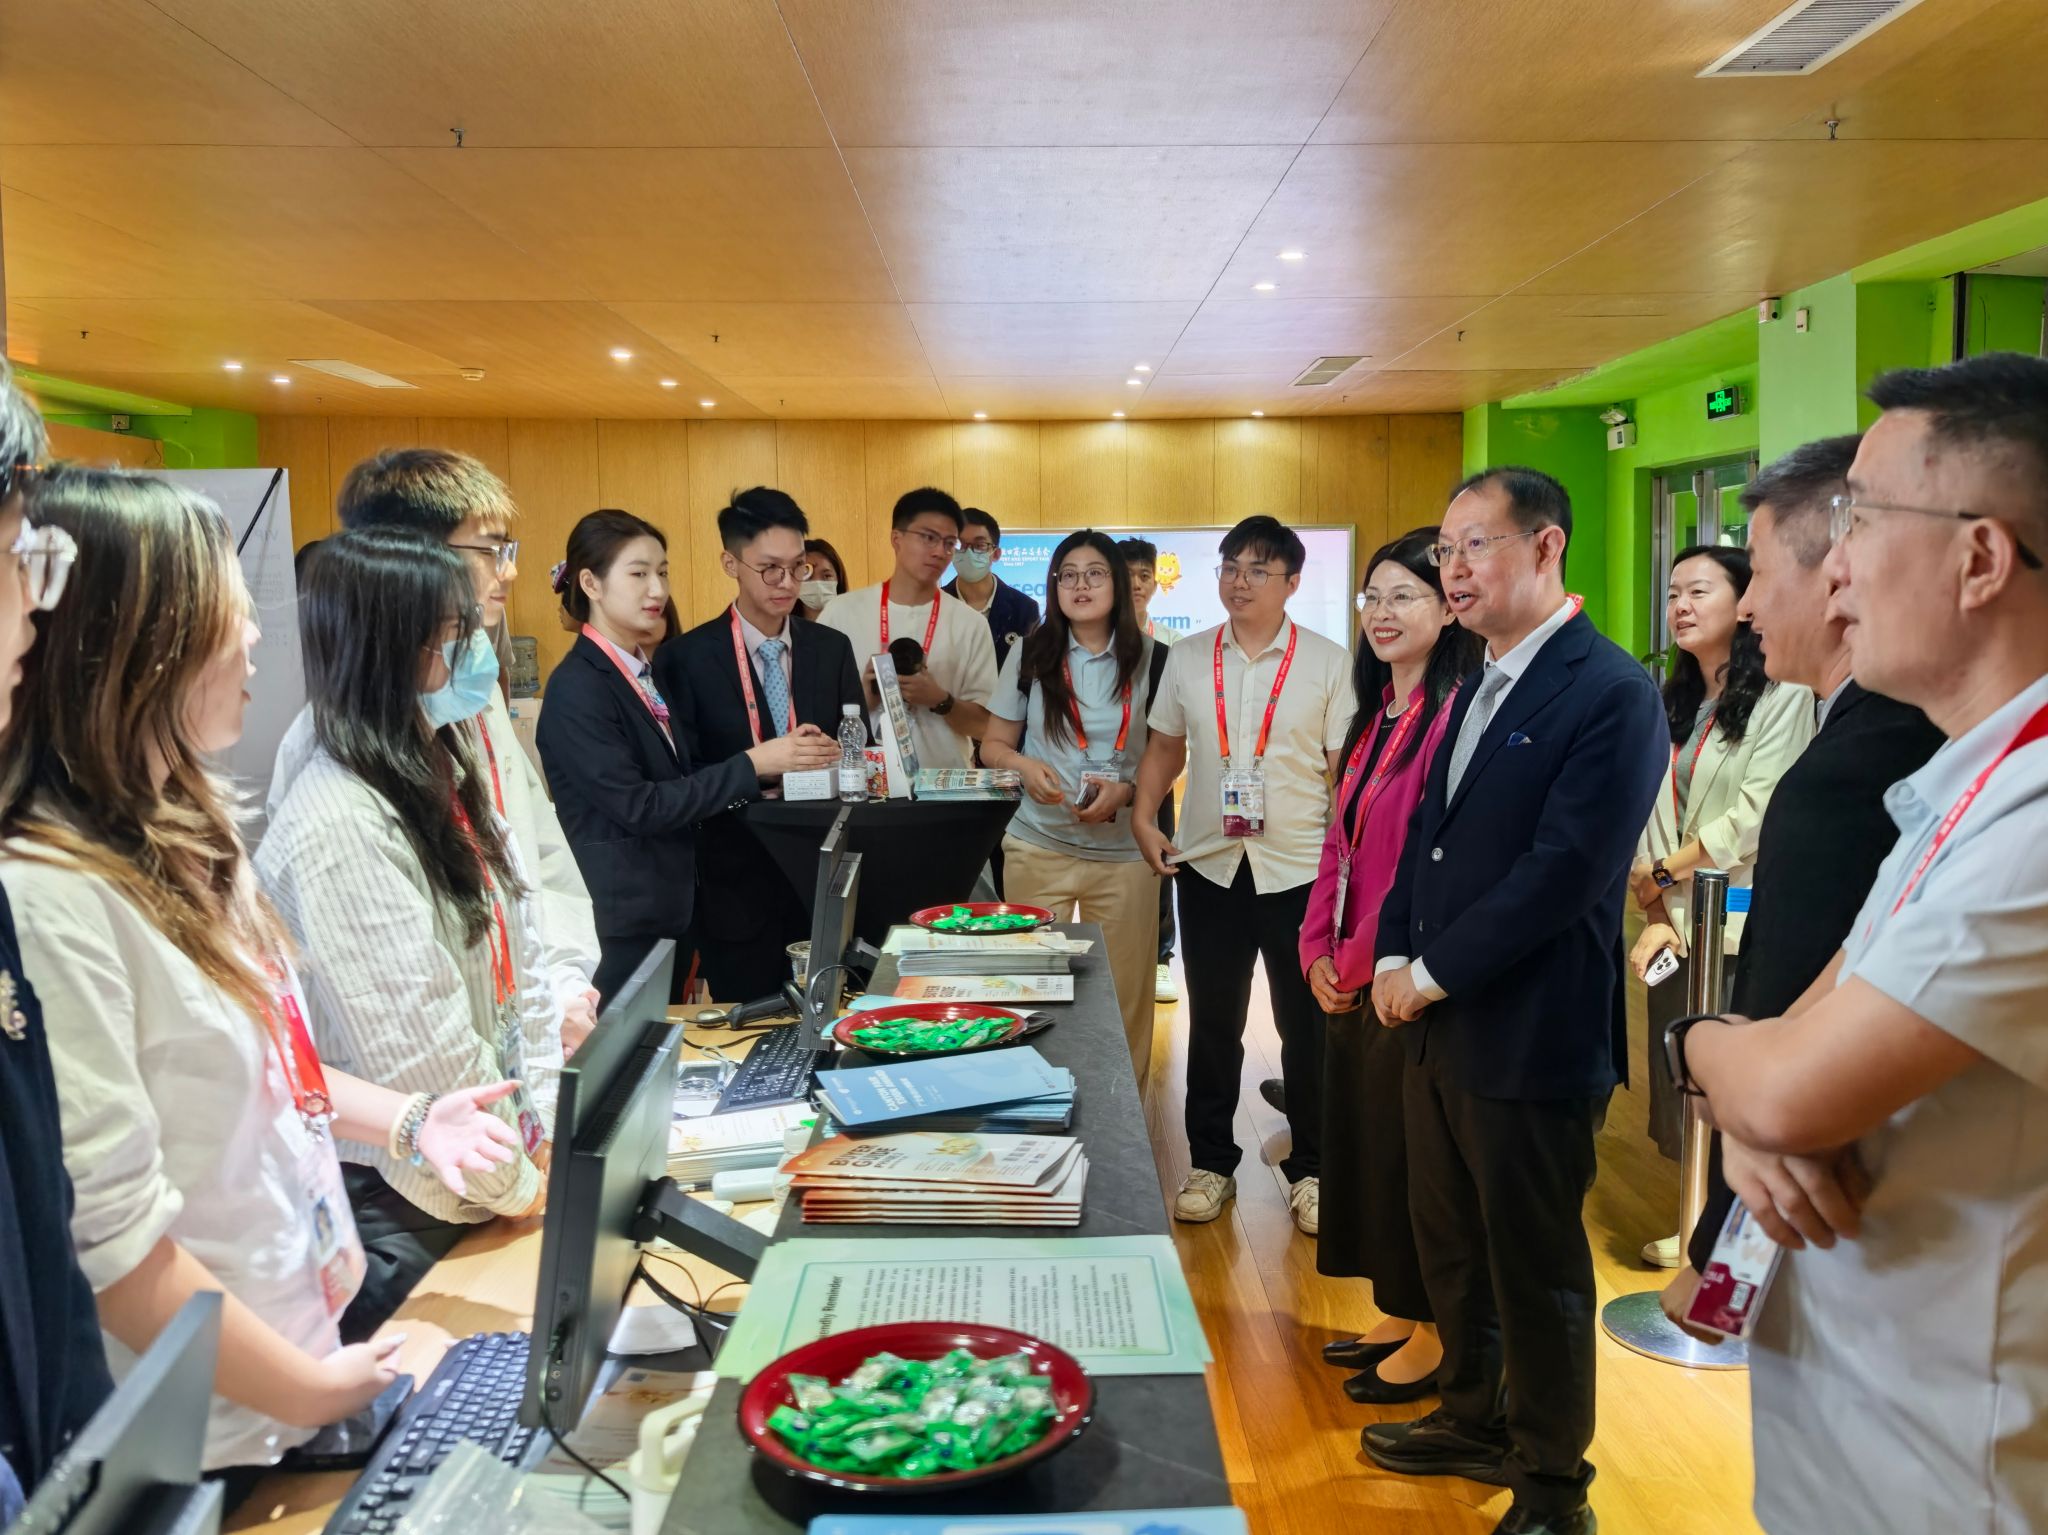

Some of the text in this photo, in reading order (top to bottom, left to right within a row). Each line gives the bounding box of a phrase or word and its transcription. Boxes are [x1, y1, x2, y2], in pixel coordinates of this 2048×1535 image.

[828, 1144, 879, 1166] BUYER
[852, 1147, 897, 1167] GUIDE
[819, 1275, 844, 1337] endly Reminder
